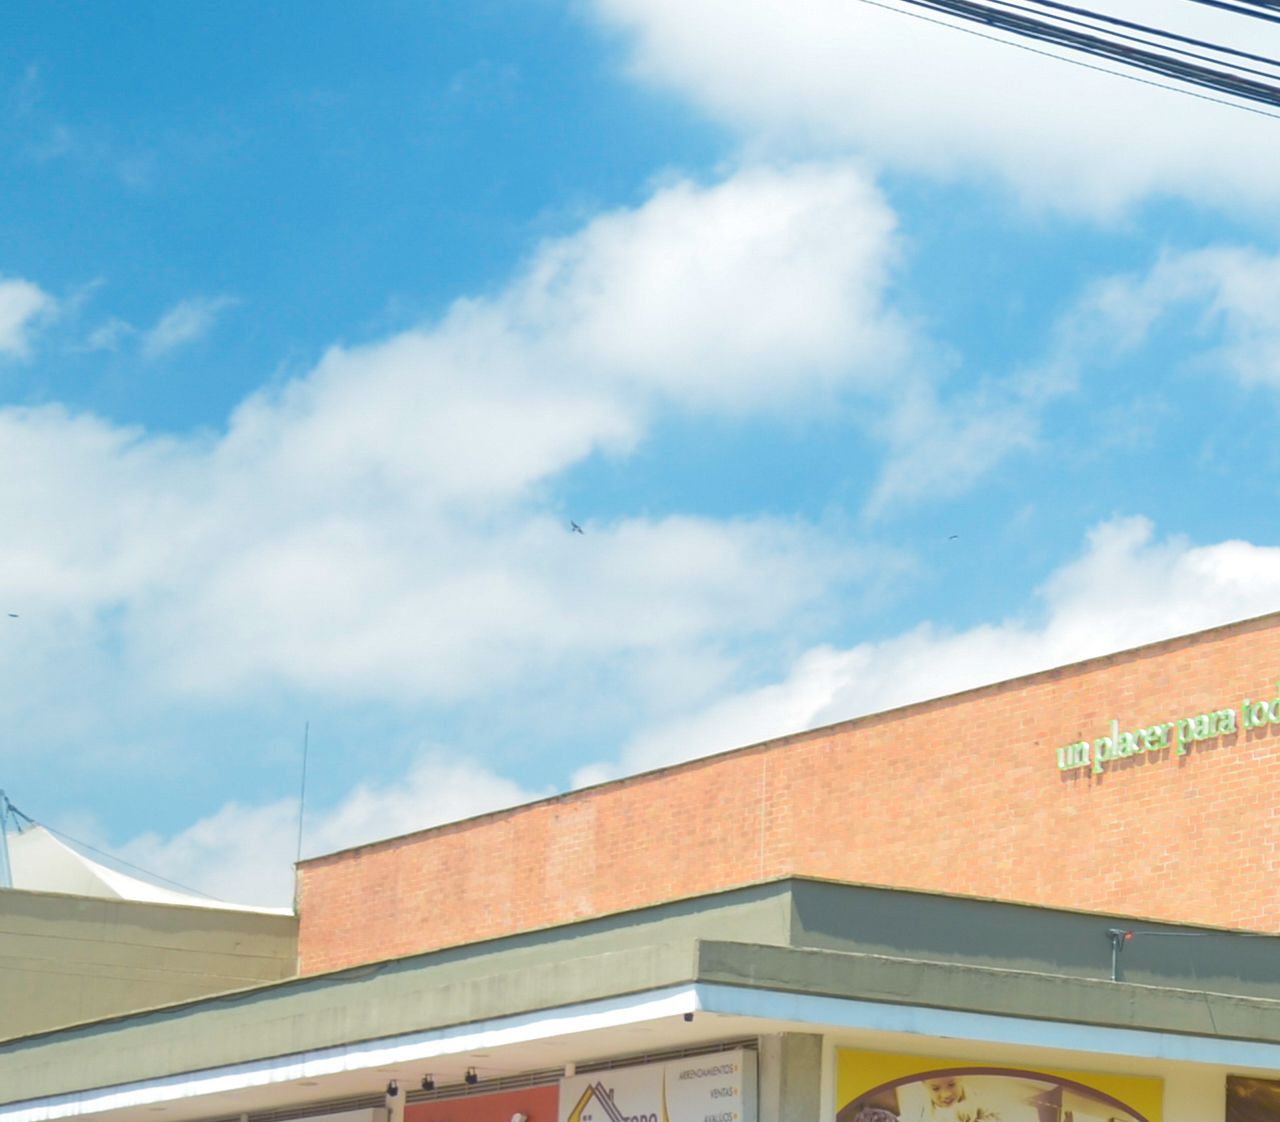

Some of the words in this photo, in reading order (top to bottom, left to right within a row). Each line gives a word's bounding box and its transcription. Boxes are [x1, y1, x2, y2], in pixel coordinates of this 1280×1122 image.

[1056, 741, 1090, 771] un
[1093, 719, 1174, 773] placer
[1174, 707, 1237, 755] para
[710, 1088, 733, 1099] VENTAS
